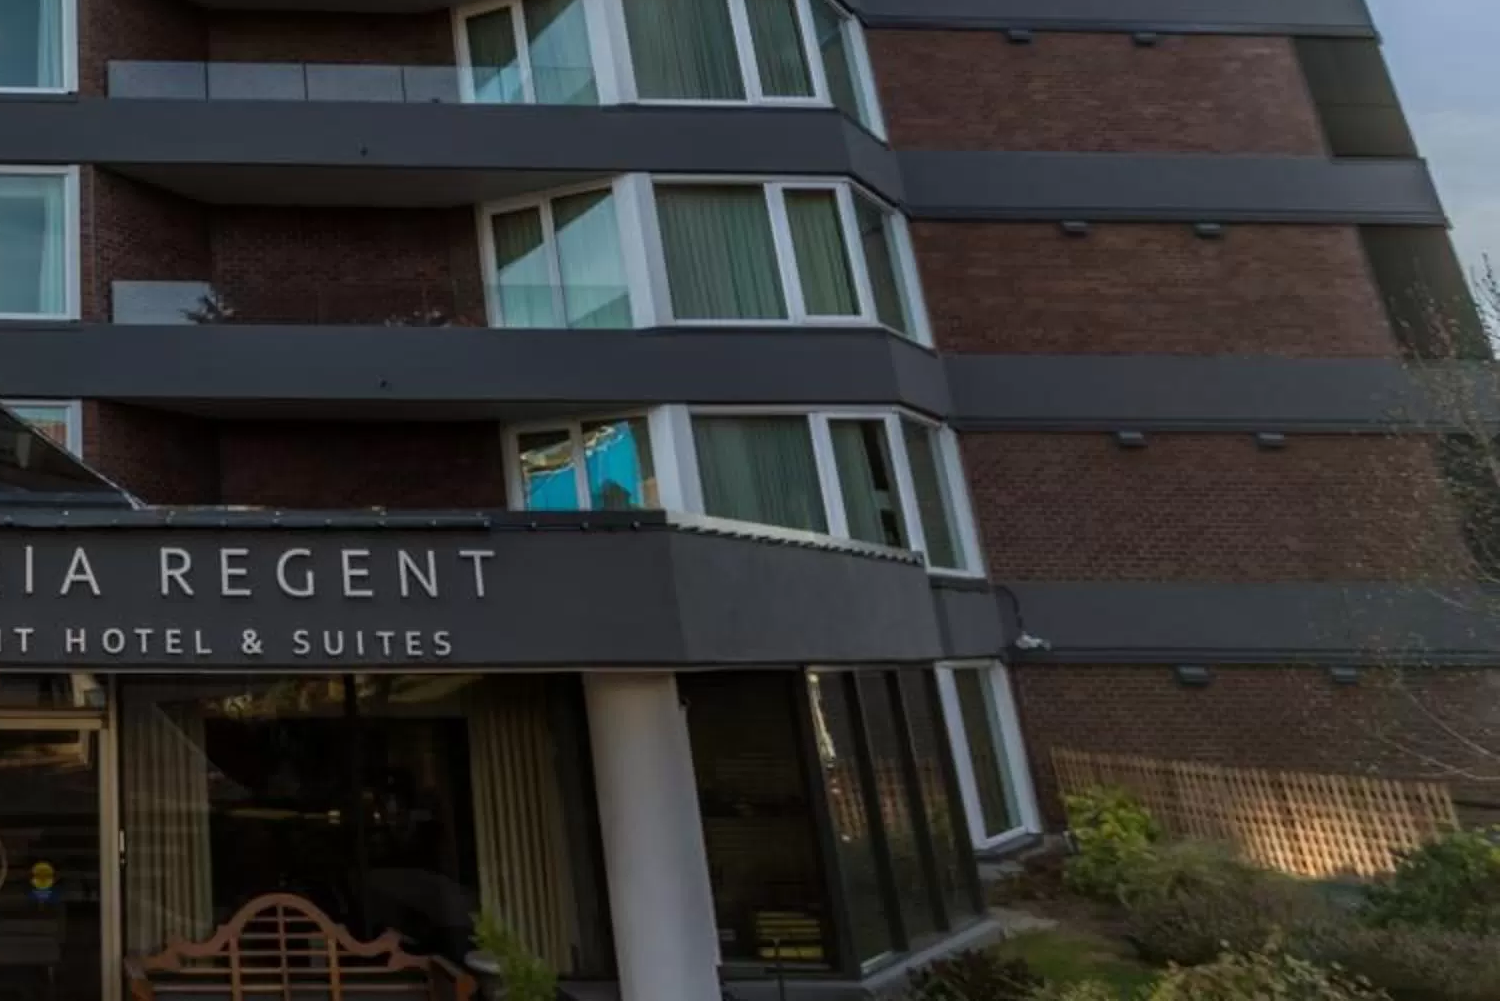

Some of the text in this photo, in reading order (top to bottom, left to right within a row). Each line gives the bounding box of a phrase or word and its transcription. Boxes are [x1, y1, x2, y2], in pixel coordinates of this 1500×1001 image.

[159, 546, 496, 598] REGENT
[64, 627, 213, 655] HOTEL
[240, 627, 264, 655] &
[292, 629, 453, 657] SUITES
